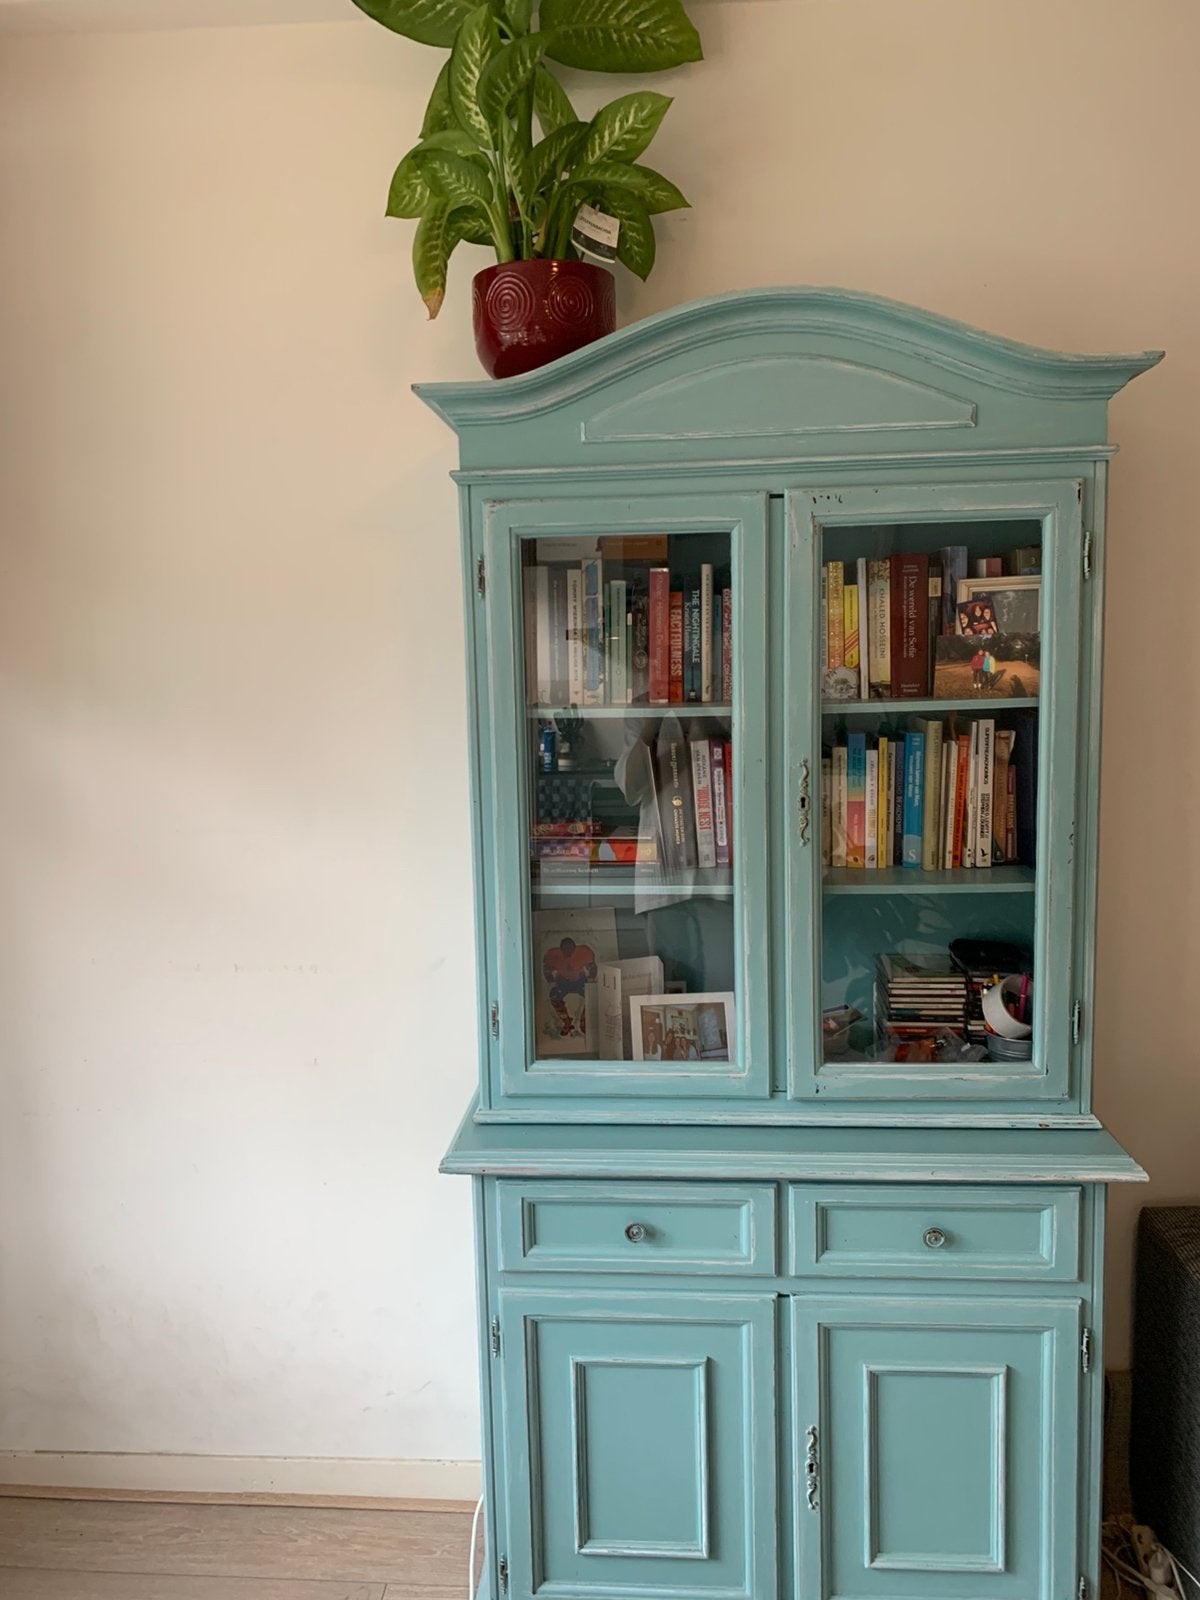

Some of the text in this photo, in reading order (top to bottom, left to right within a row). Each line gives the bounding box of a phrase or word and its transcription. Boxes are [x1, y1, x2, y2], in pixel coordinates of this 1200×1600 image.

[908, 576, 918, 588] De
[908, 590, 918, 618] wereld
[692, 590, 700, 664] THE NIGHTINGALE
[670, 608, 682, 676] FACTFULNESS
[908, 636, 918, 658] Sofie
[698, 812, 711, 830] NEST
[908, 848, 917, 861] S
